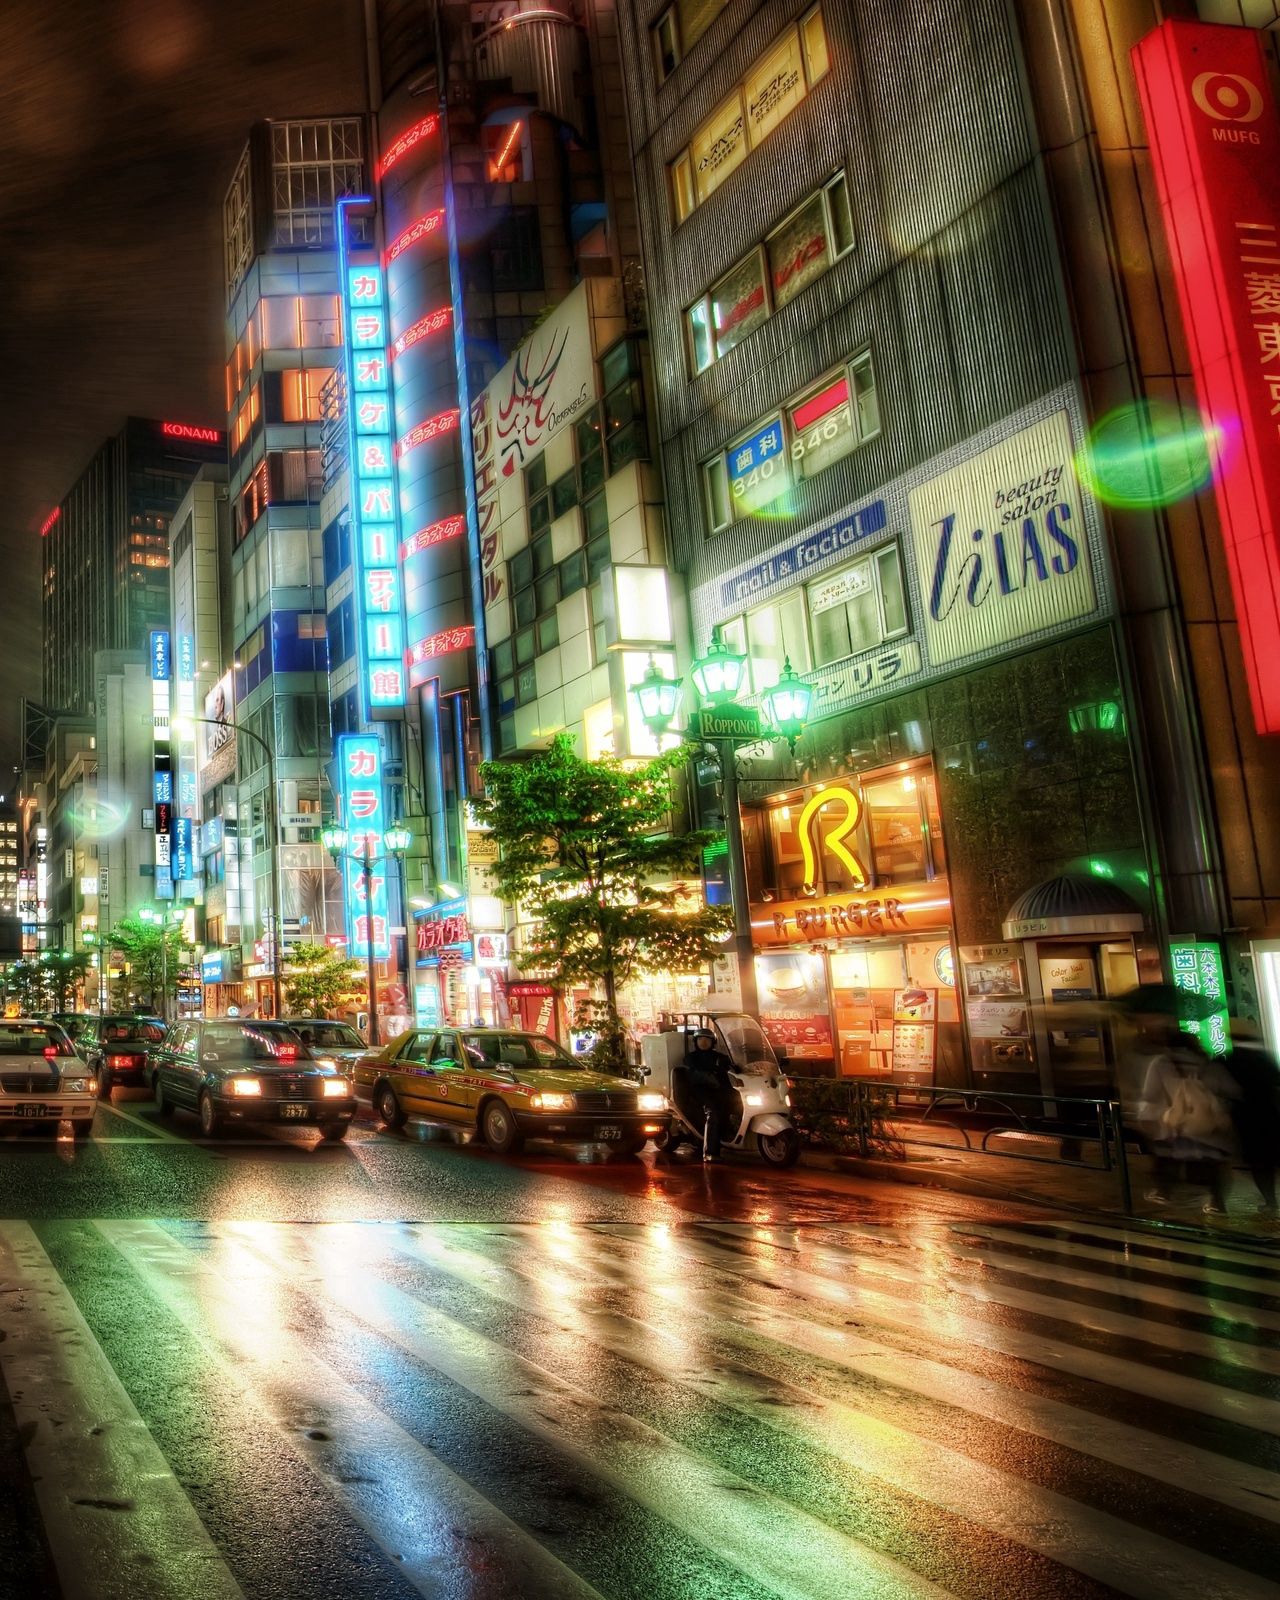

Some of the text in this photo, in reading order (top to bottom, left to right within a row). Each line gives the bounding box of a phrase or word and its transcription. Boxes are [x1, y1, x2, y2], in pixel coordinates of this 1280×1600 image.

[1212, 127, 1261, 146] MUFG
[163, 422, 218, 442] KONAMI
[736, 430, 778, 474] 歯科
[471, 391, 505, 609] オリエンタル
[994, 464, 1065, 509] beauty
[1000, 488, 1058, 527] salon
[735, 514, 864, 596] nail & facial
[853, 652, 903, 689] リラ
[702, 712, 759, 734] ROPPONGI
[348, 747, 387, 947] カラオケ館
[798, 786, 865, 896] R
[417, 912, 469, 950] カラオケ館
[794, 897, 902, 931] BURGER
[1015, 924, 1048, 932] リラビル
[1050, 967, 1068, 978] Color
[1173, 948, 1201, 995] 歯科
[279, 1046, 295, 1056] 空車
[468, 1078, 487, 1087] TAXI
[285, 1108, 308, 1118] 28-77
